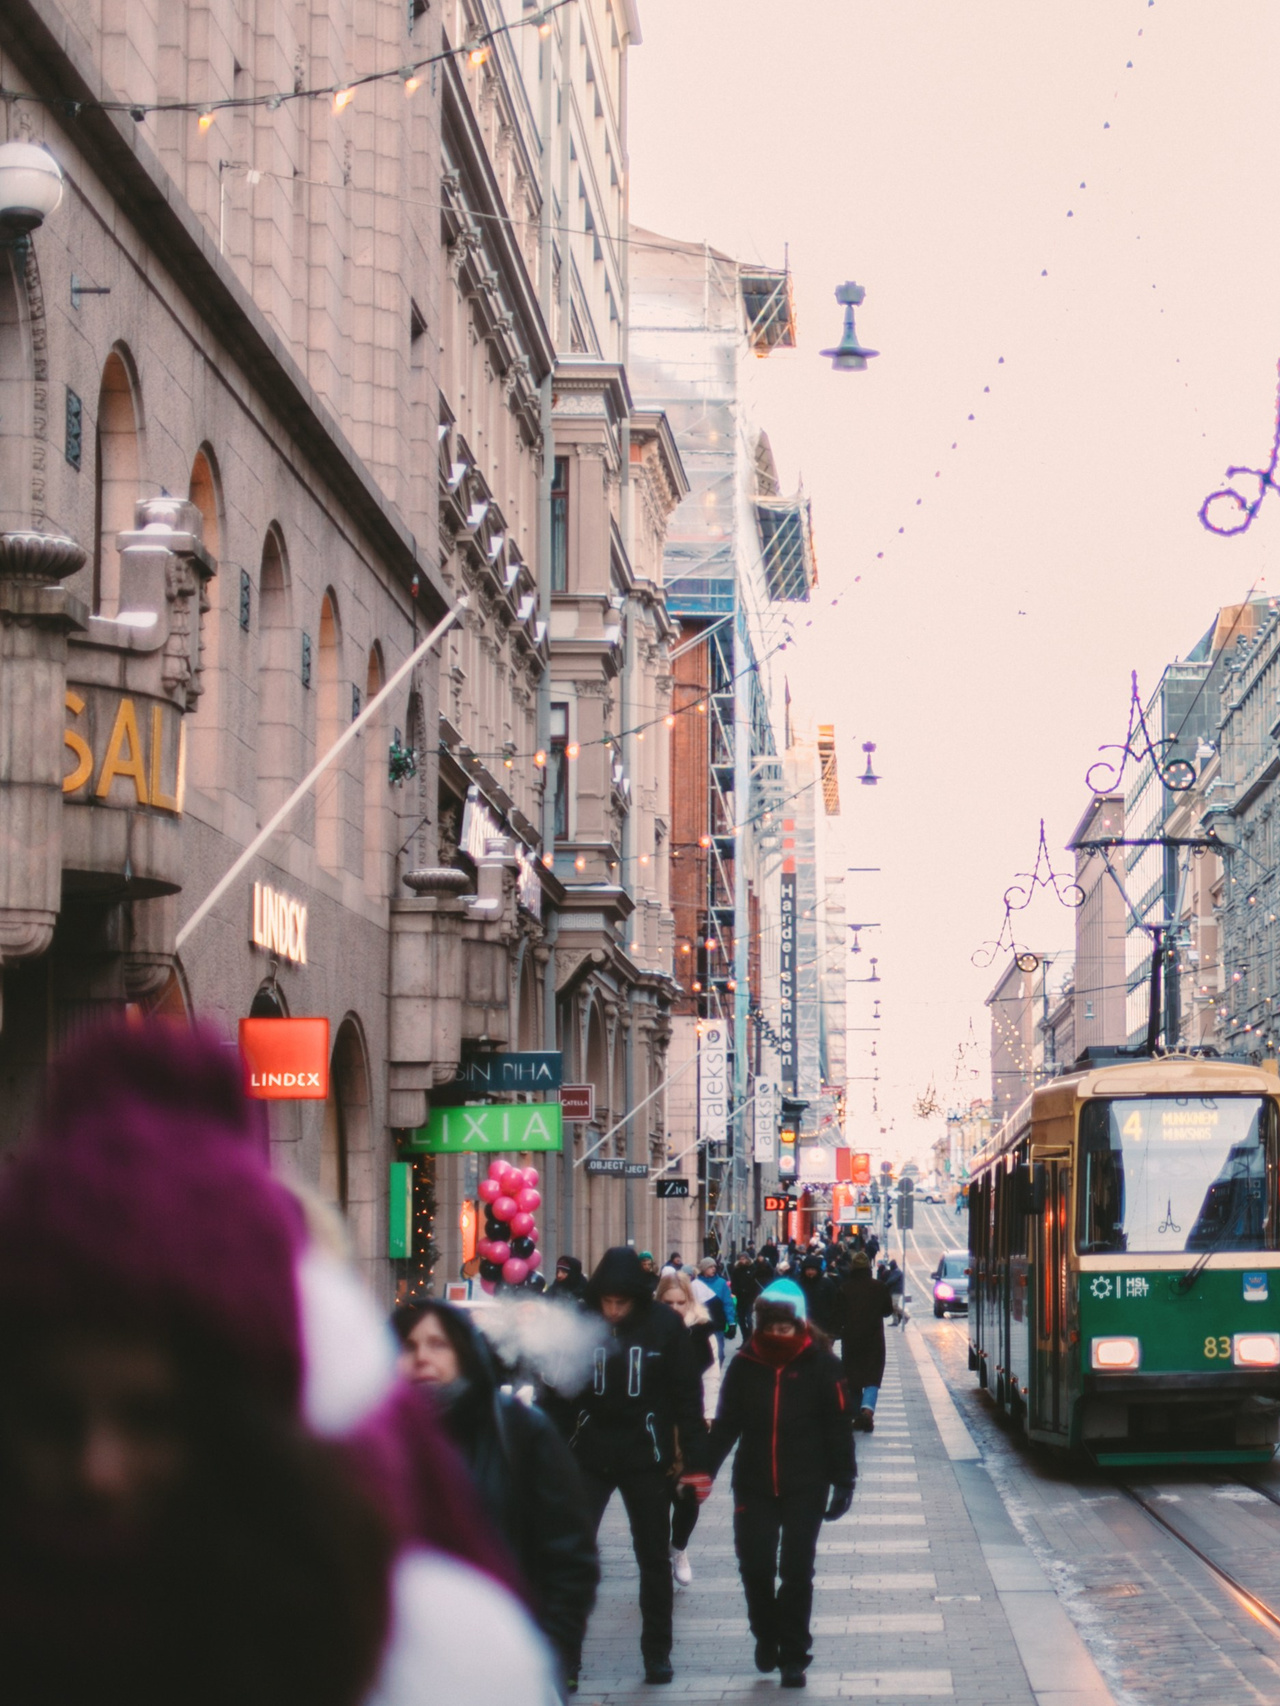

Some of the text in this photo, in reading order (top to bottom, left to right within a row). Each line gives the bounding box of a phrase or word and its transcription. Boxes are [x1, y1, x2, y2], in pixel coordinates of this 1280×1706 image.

[781, 884, 793, 1066] Handelsbanken
[251, 1072, 320, 1087] LINDEX
[702, 1047, 723, 1117] aleksi
[1122, 1109, 1143, 1141] 4
[665, 1182, 688, 1195] Zio
[1126, 1277, 1149, 1288] HSL
[1126, 1287, 1148, 1297] HRT
[1204, 1336, 1231, 1358] 83
